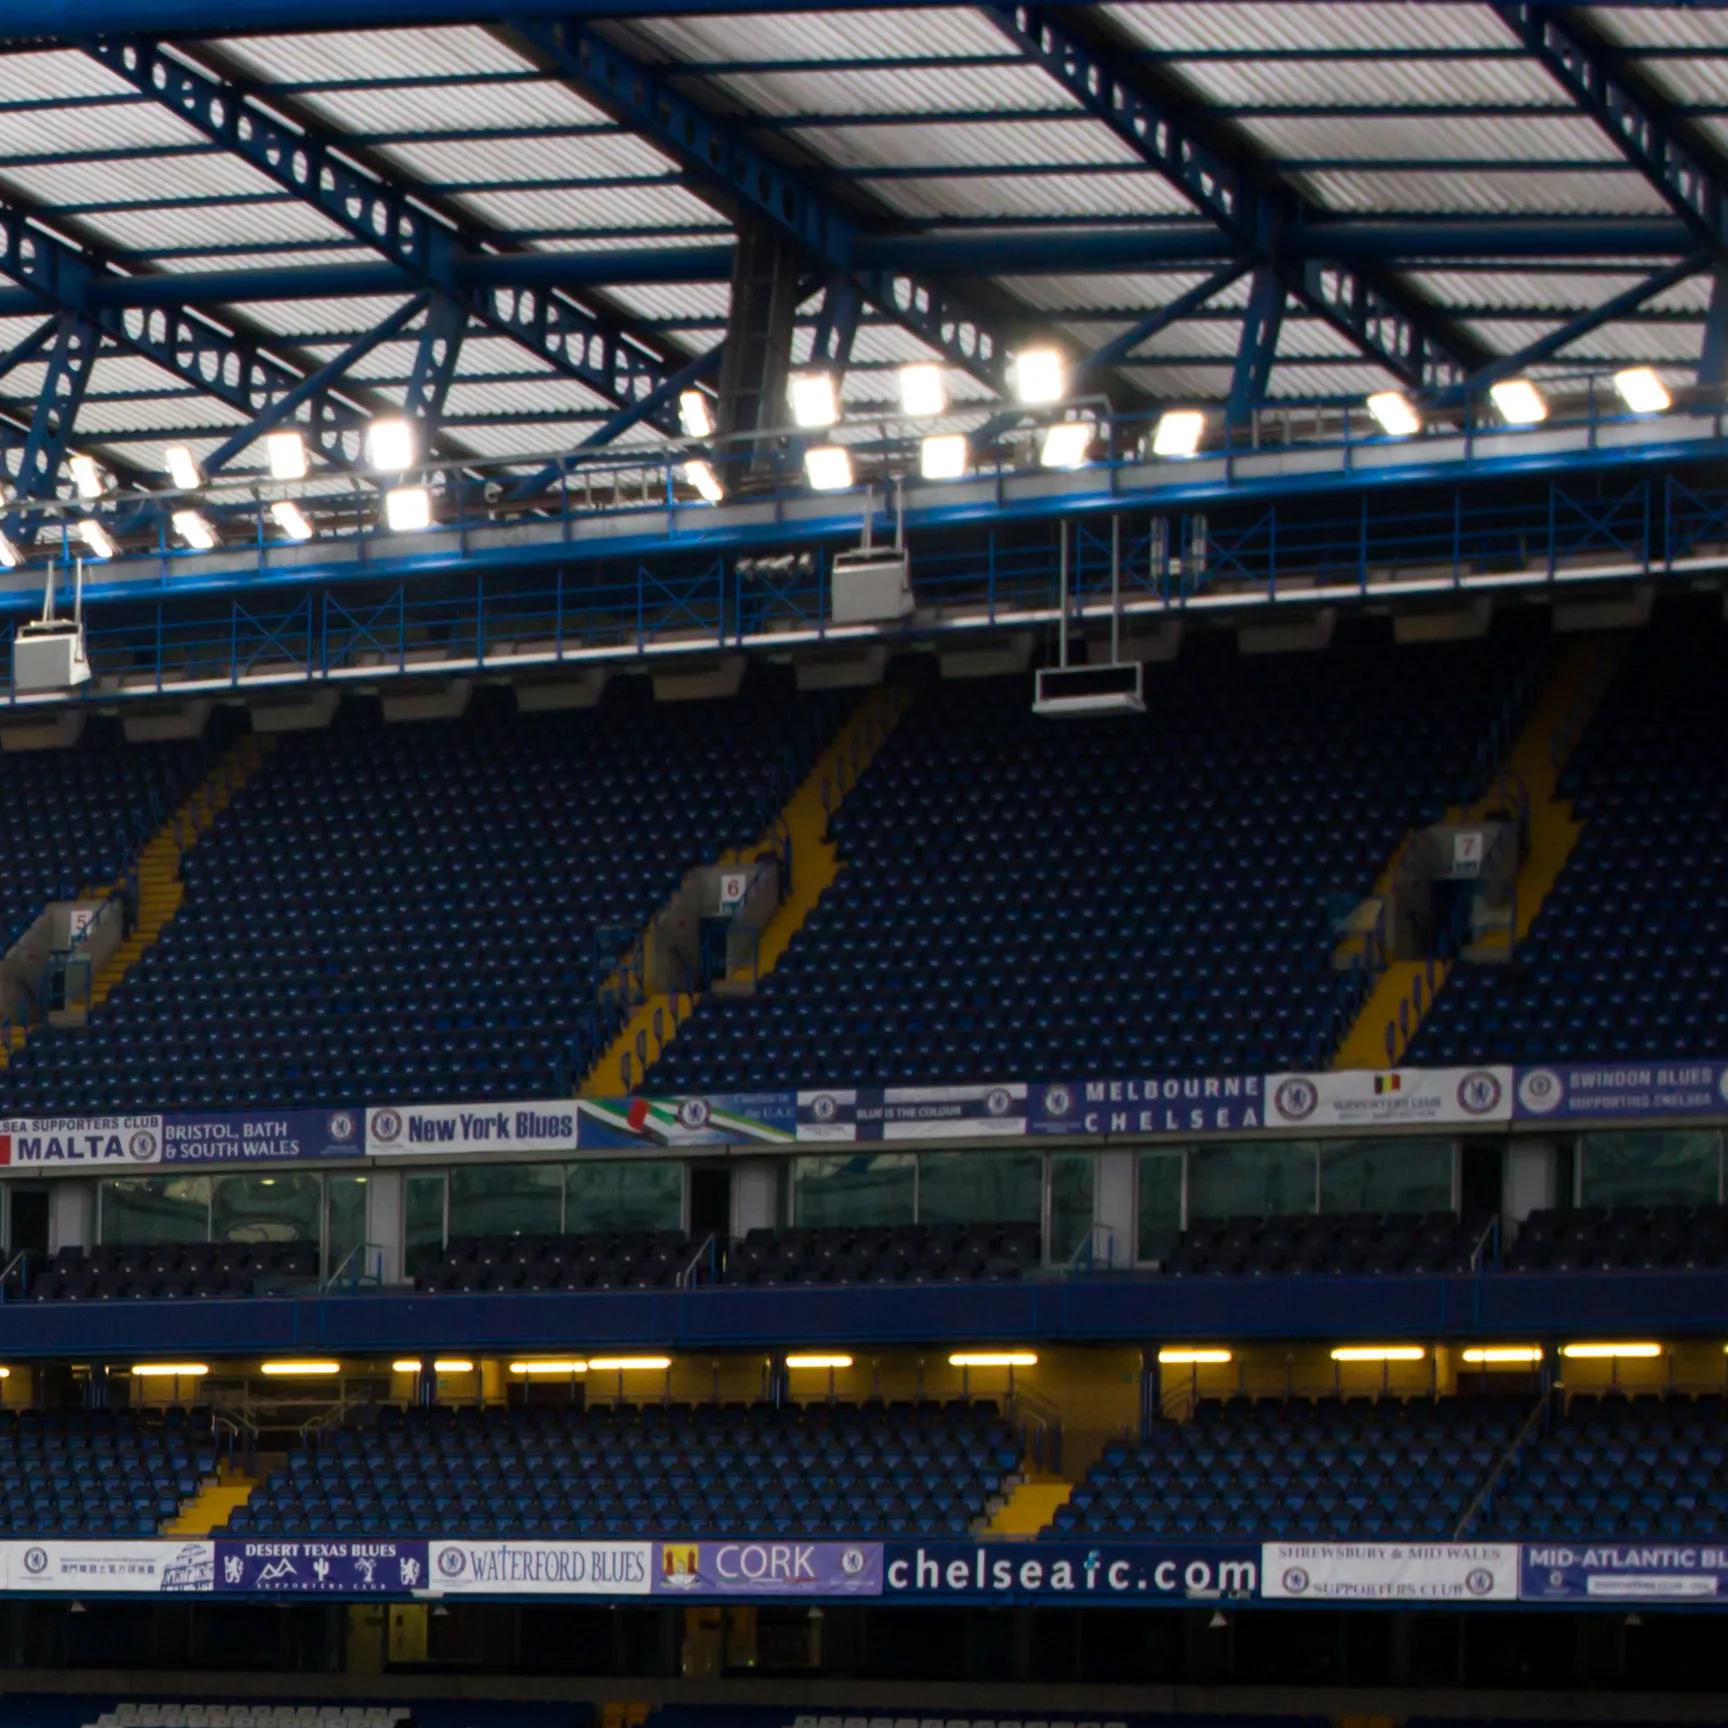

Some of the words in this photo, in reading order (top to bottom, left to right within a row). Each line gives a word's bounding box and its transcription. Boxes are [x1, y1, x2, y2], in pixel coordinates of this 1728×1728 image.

[1463, 838, 1473, 856] 7
[728, 879, 739, 897] 6
[1570, 1070, 1650, 1089] SWINDON
[1657, 1067, 1712, 1086] BLUES
[1086, 1076, 1257, 1101] MELBOURNE
[857, 1108, 881, 1119] BLUE
[885, 1107, 894, 1118] IS
[897, 1107, 916, 1117] THE
[918, 1106, 961, 1117] COLOUR
[1084, 1107, 1257, 1131] CHELSEA
[32, 1118, 119, 1132] SUPPORTERS
[124, 1117, 159, 1129] CLUB
[166, 1124, 239, 1141] BRISTOL,
[243, 1121, 287, 1137] BATH
[408, 1115, 455, 1143] New
[459, 1113, 510, 1141] York
[516, 1112, 572, 1139] Blues
[18, 1135, 124, 1160] MALTA
[166, 1145, 176, 1159] &
[180, 1143, 238, 1158] SOUTH
[243, 1140, 299, 1155] WALES
[245, 1543, 300, 1557] DESERT
[303, 1543, 347, 1557] TEXAS
[351, 1543, 396, 1557] BLUES
[1278, 1546, 1386, 1559] SHREWSBURY
[1391, 1547, 1402, 1558] &
[1408, 1547, 1443, 1559] MID
[1447, 1547, 1501, 1559] WALES
[1530, 1548, 1696, 1568] MID-ATLANTIC
[471, 1545, 585, 1582] WATERFORD
[591, 1551, 645, 1582] BLUES
[716, 1545, 815, 1579] CORK
[887, 1548, 1256, 1591] chelseafc.com
[257, 1582, 343, 1590] SUPPORTERS
[353, 1582, 386, 1590] CLUB
[1313, 1584, 1416, 1596] SUPPORTERS
[1420, 1584, 1463, 1596] CLUB
